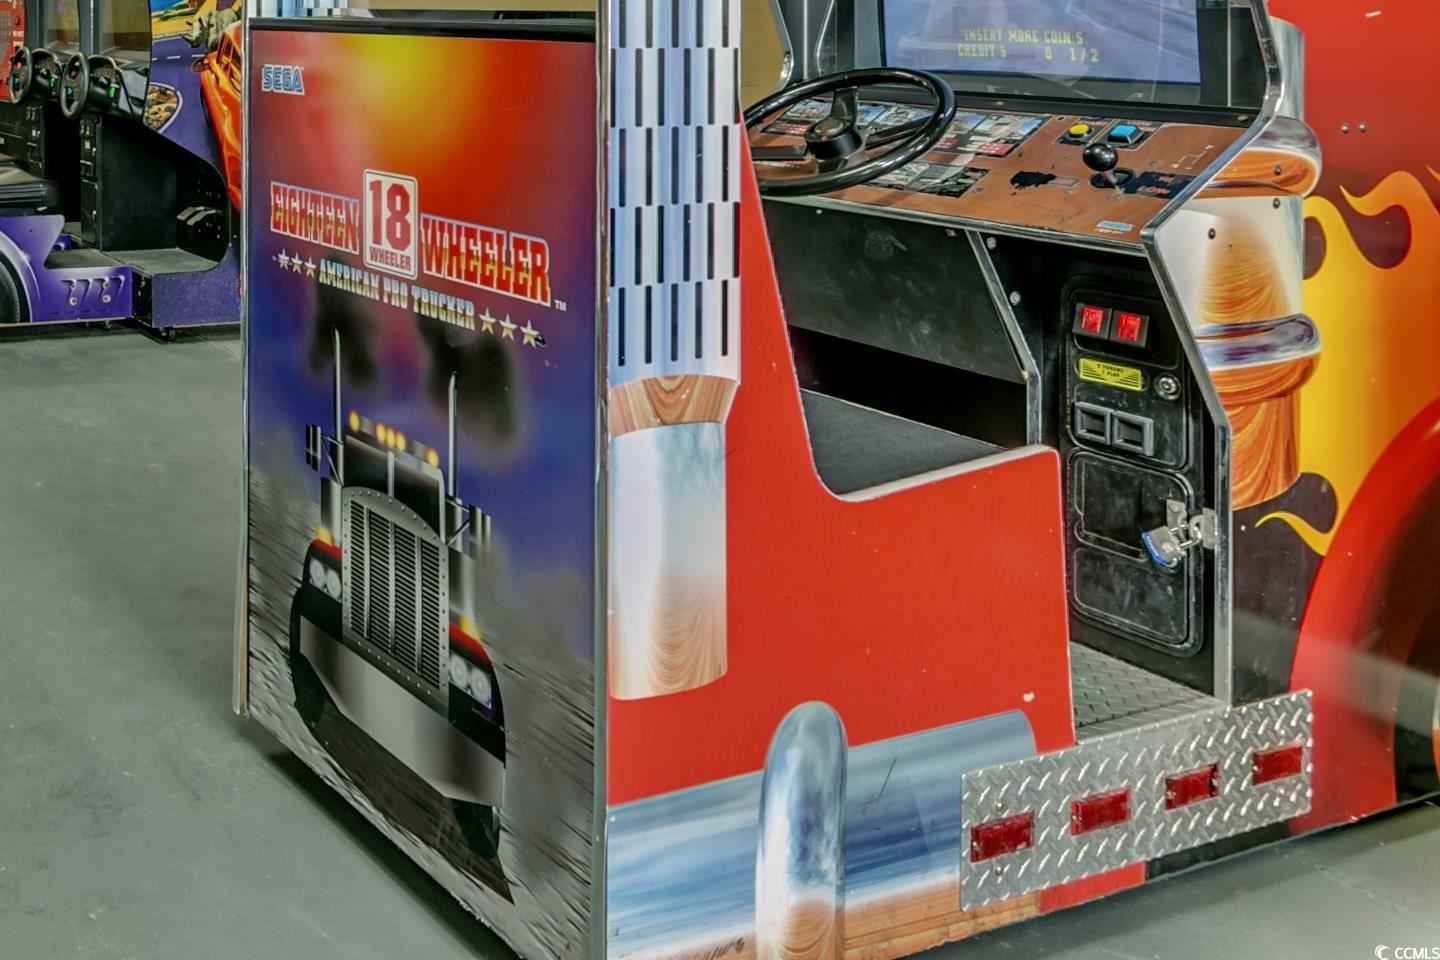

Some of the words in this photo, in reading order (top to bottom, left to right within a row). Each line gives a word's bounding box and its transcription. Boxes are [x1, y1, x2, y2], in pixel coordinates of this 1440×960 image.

[964, 28, 1002, 42] INSERT
[1008, 29, 1039, 43] MORE
[262, 64, 305, 95] SEGA
[271, 181, 359, 255] EIGHTEEN
[369, 180, 411, 252] 18
[420, 213, 551, 307] WHEELER
[369, 246, 411, 271] WHEELER
[319, 259, 380, 300] AMERICAN
[383, 276, 408, 310] PRO
[412, 284, 476, 331] TRUCKER
